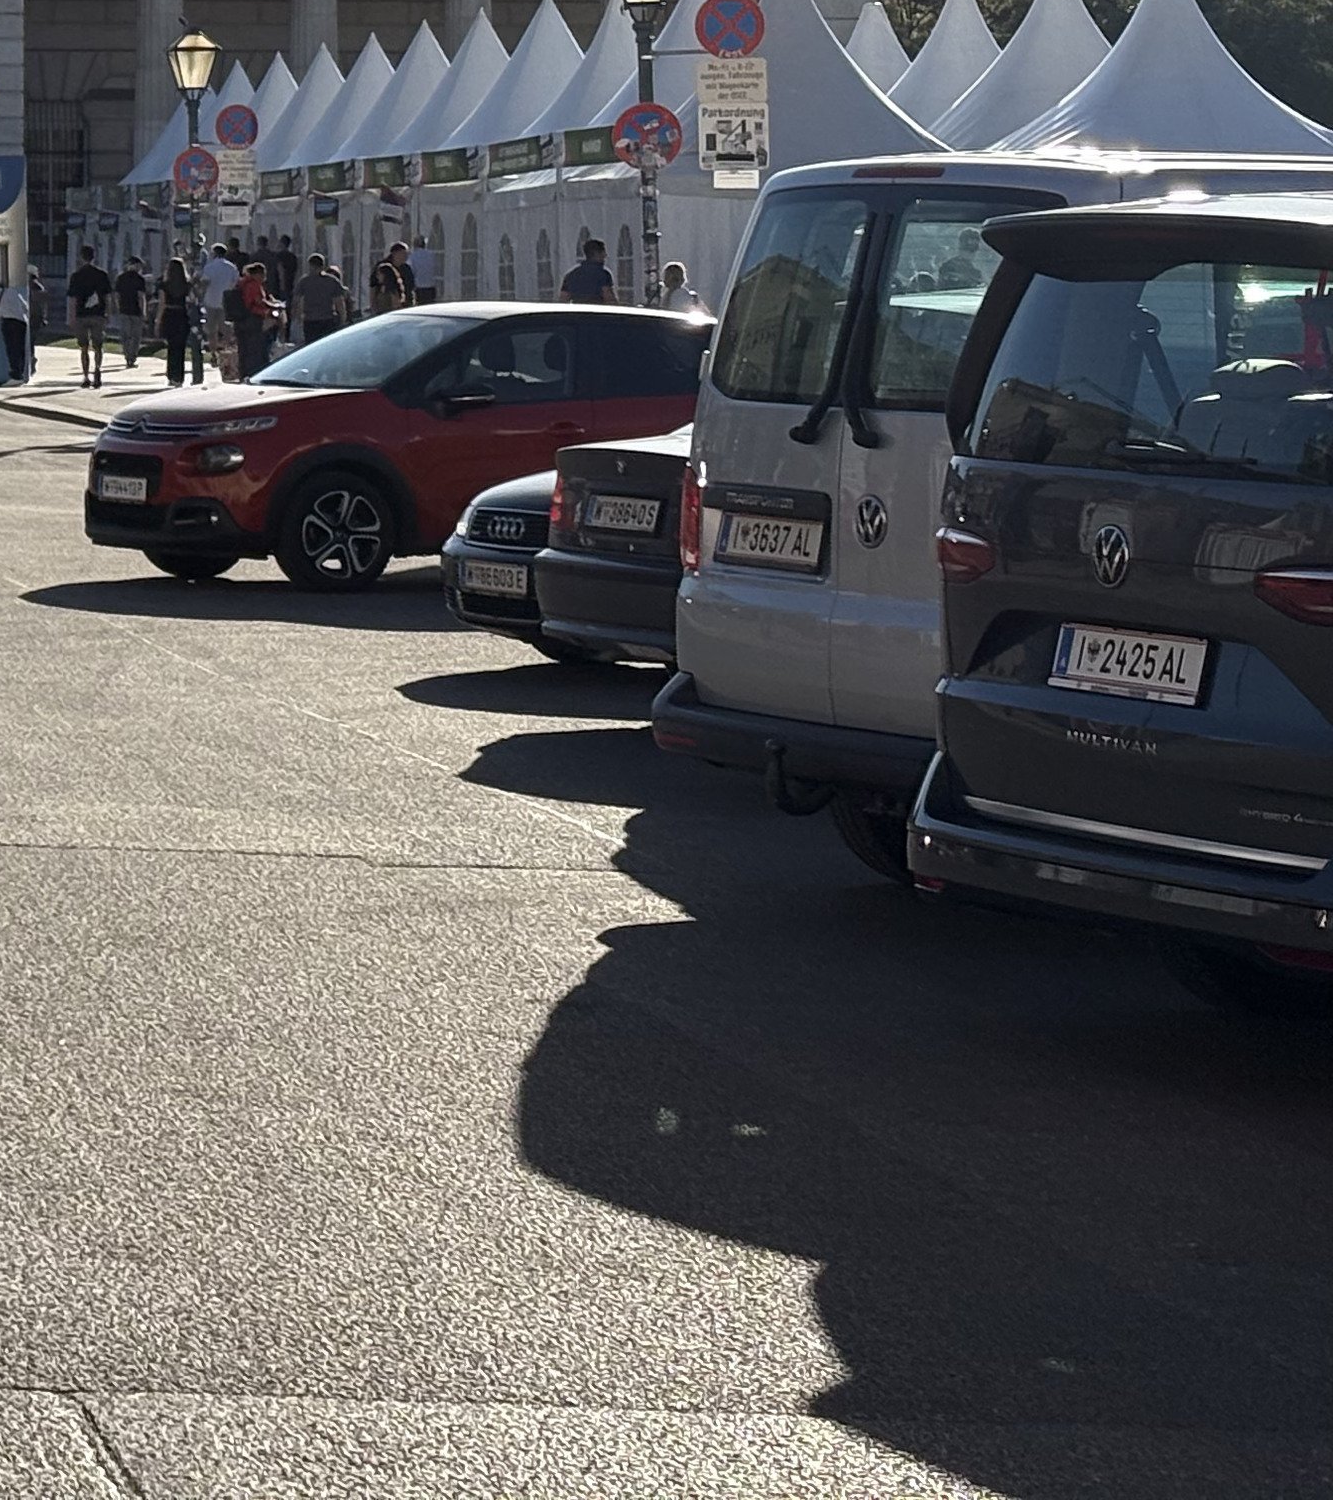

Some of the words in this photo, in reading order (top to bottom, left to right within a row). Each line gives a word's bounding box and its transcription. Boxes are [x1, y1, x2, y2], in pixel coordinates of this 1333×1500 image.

[701, 107, 766, 120] Parkordnung
[749, 523, 791, 555] 3637
[791, 526, 811, 558] AL
[1099, 639, 1159, 680] 2425
[1158, 646, 1186, 685] AL
[1066, 729, 1158, 756] MULTIVAN
